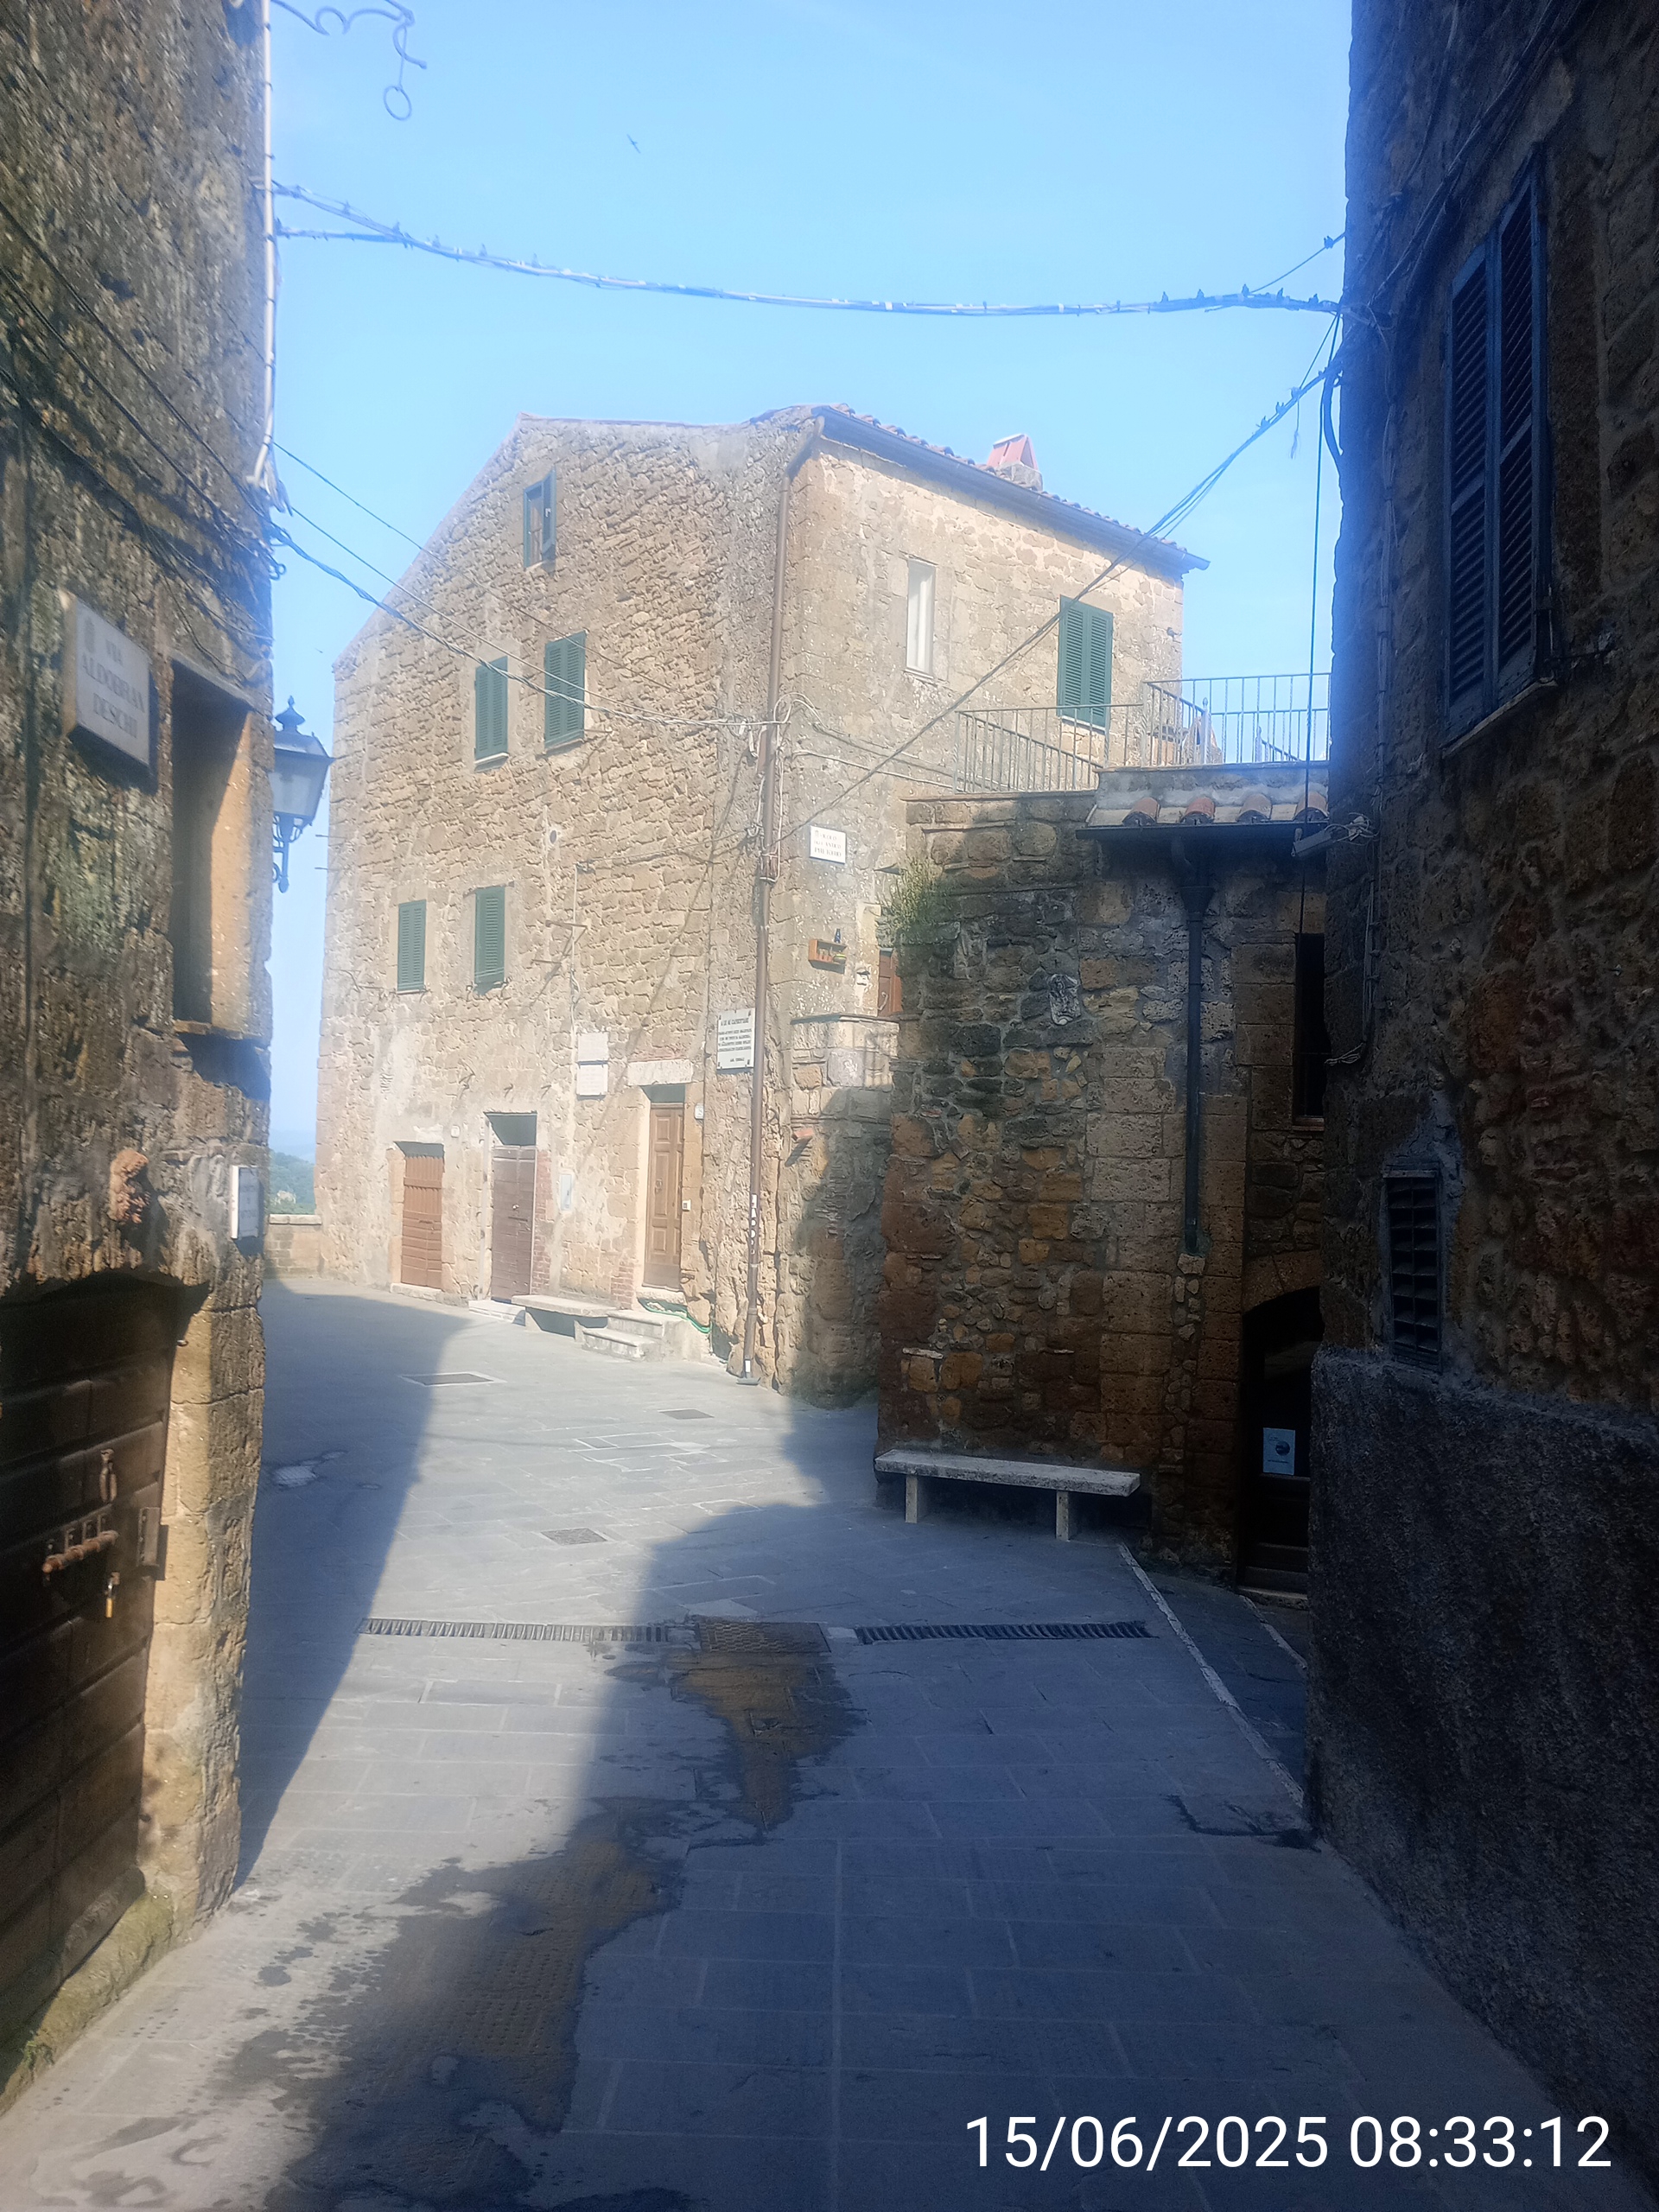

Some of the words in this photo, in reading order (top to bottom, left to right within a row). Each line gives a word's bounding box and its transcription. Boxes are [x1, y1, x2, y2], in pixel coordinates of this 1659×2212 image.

[105, 639, 124, 667] VIA
[81, 652, 145, 713] ALDOBRAN
[92, 691, 138, 738] DESCHI
